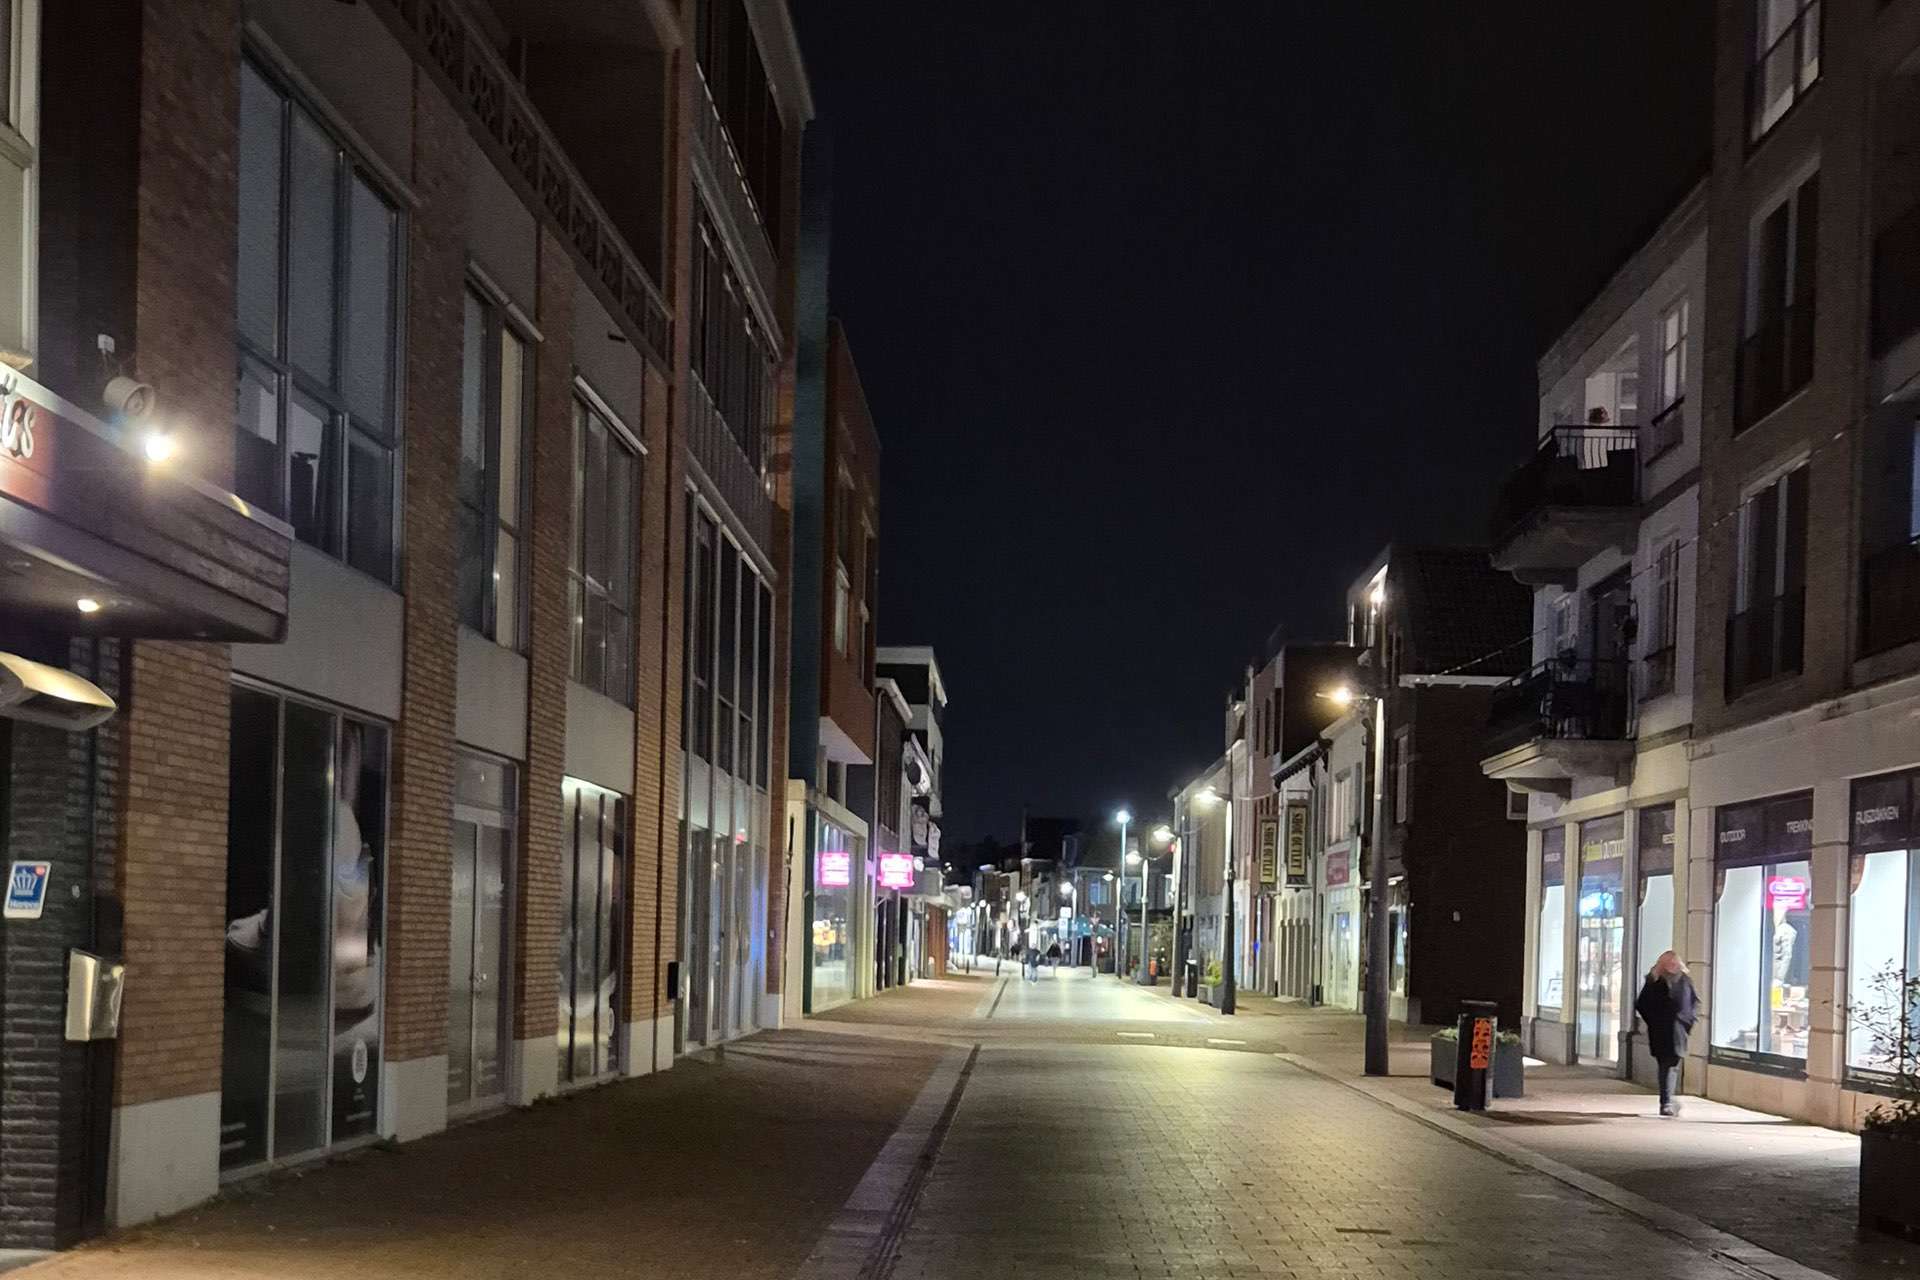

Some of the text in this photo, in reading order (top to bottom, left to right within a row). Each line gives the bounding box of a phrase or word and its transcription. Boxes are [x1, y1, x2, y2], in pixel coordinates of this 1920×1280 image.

[1719, 828, 1746, 844] OUTDOOR
[1263, 848, 1274, 878] OUTLET
[1291, 836, 1303, 869] OUTLET
